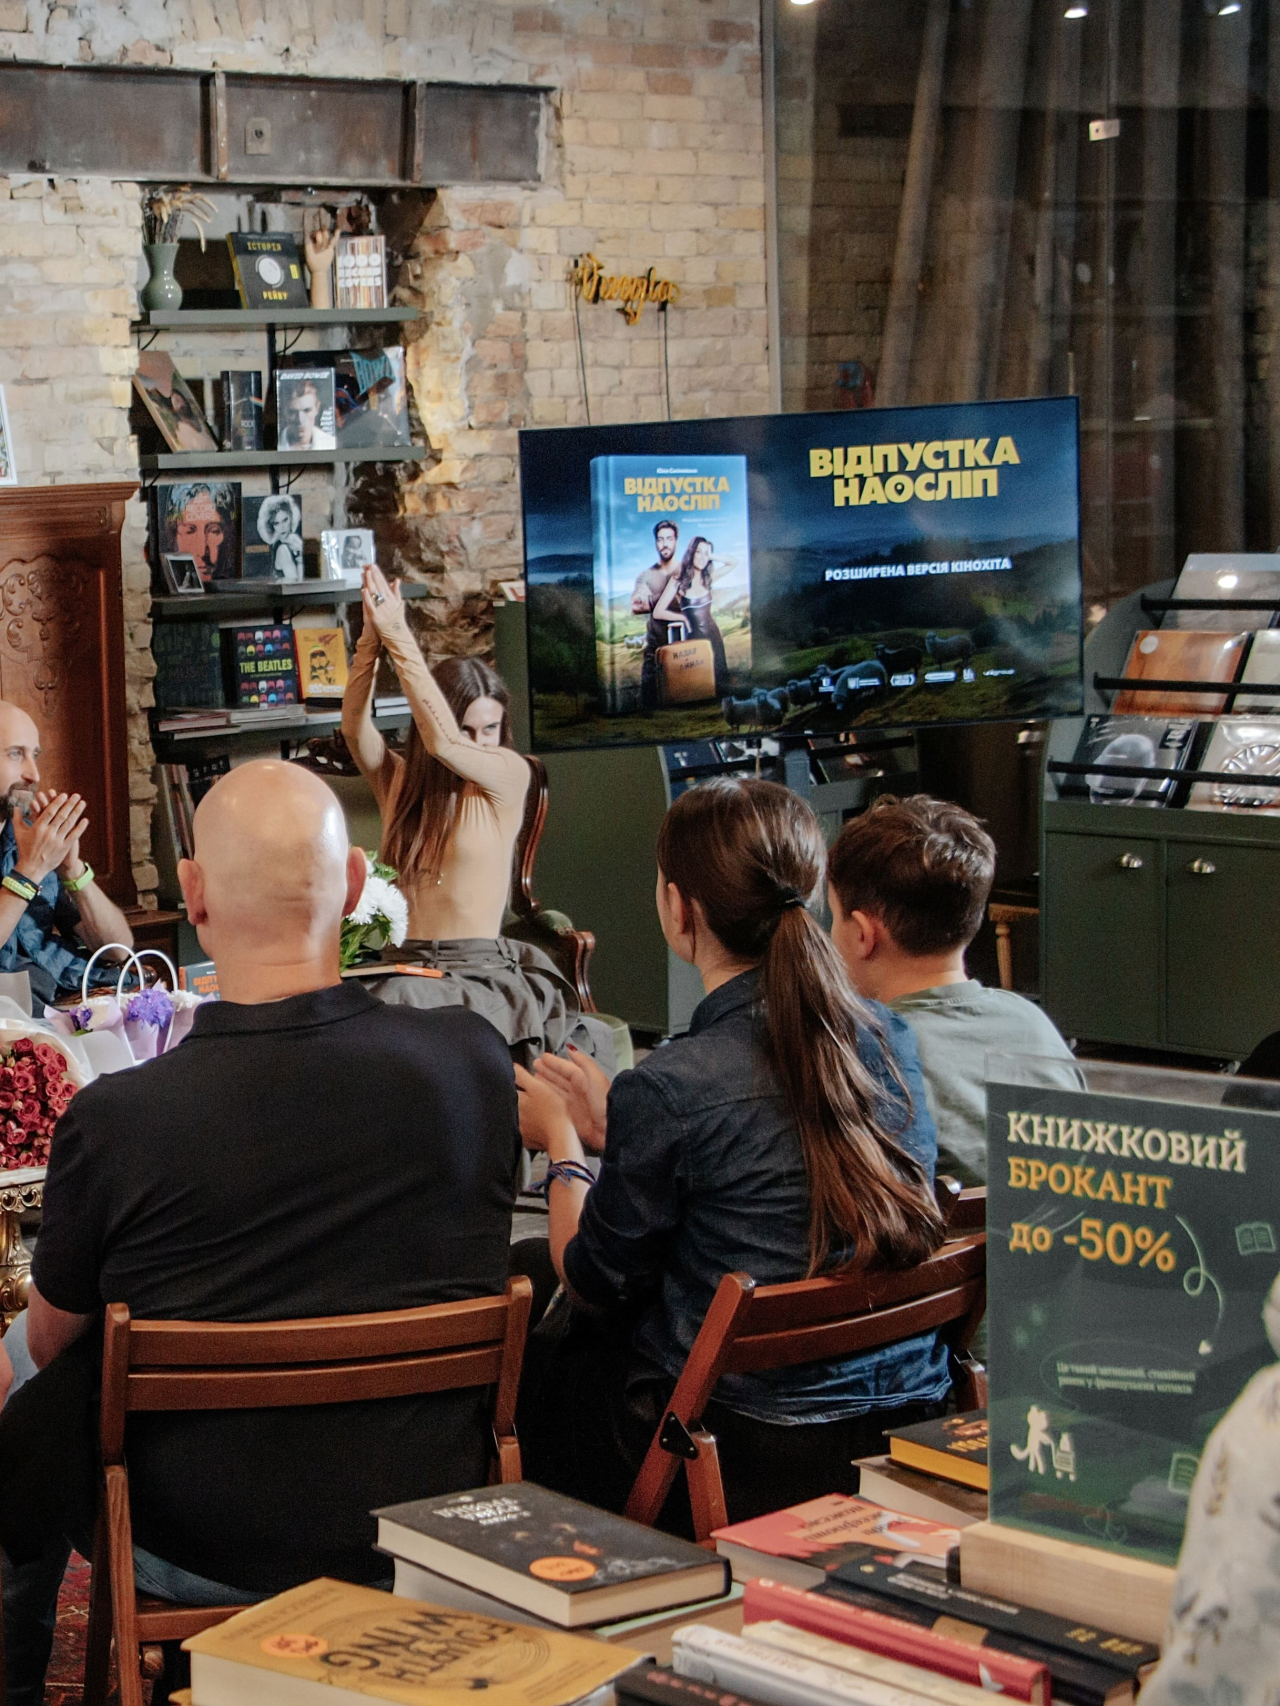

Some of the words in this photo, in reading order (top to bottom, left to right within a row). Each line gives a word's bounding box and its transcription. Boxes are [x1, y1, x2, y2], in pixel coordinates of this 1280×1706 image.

[247, 241, 282, 251] ІСТОРІЯ
[338, 276, 382, 288] COVERS
[262, 290, 289, 301] РЕЙВУ
[280, 371, 303, 380] DAVID
[303, 371, 330, 379] BOWIE
[809, 435, 1021, 479] ВІДПУСТКА
[624, 476, 731, 495] ВІДПУСТКА
[833, 468, 999, 507] НАОСЛІП
[637, 494, 721, 513] НАОСЛІП
[824, 564, 905, 582] РОЗШИРЕНА
[906, 561, 950, 577] ВЕРСІЯ
[950, 556, 1013, 574] КІНОХІТА
[239, 661, 255, 674] THE
[257, 658, 293, 672] BEATLES
[1006, 1111, 1247, 1174] КНИЖКОВИЙ
[1007, 1156, 1173, 1209] БРОКАНТ
[1009, 1222, 1053, 1255] до
[1063, 1218, 1177, 1273] -50%
[318, 1610, 476, 1672] WING
